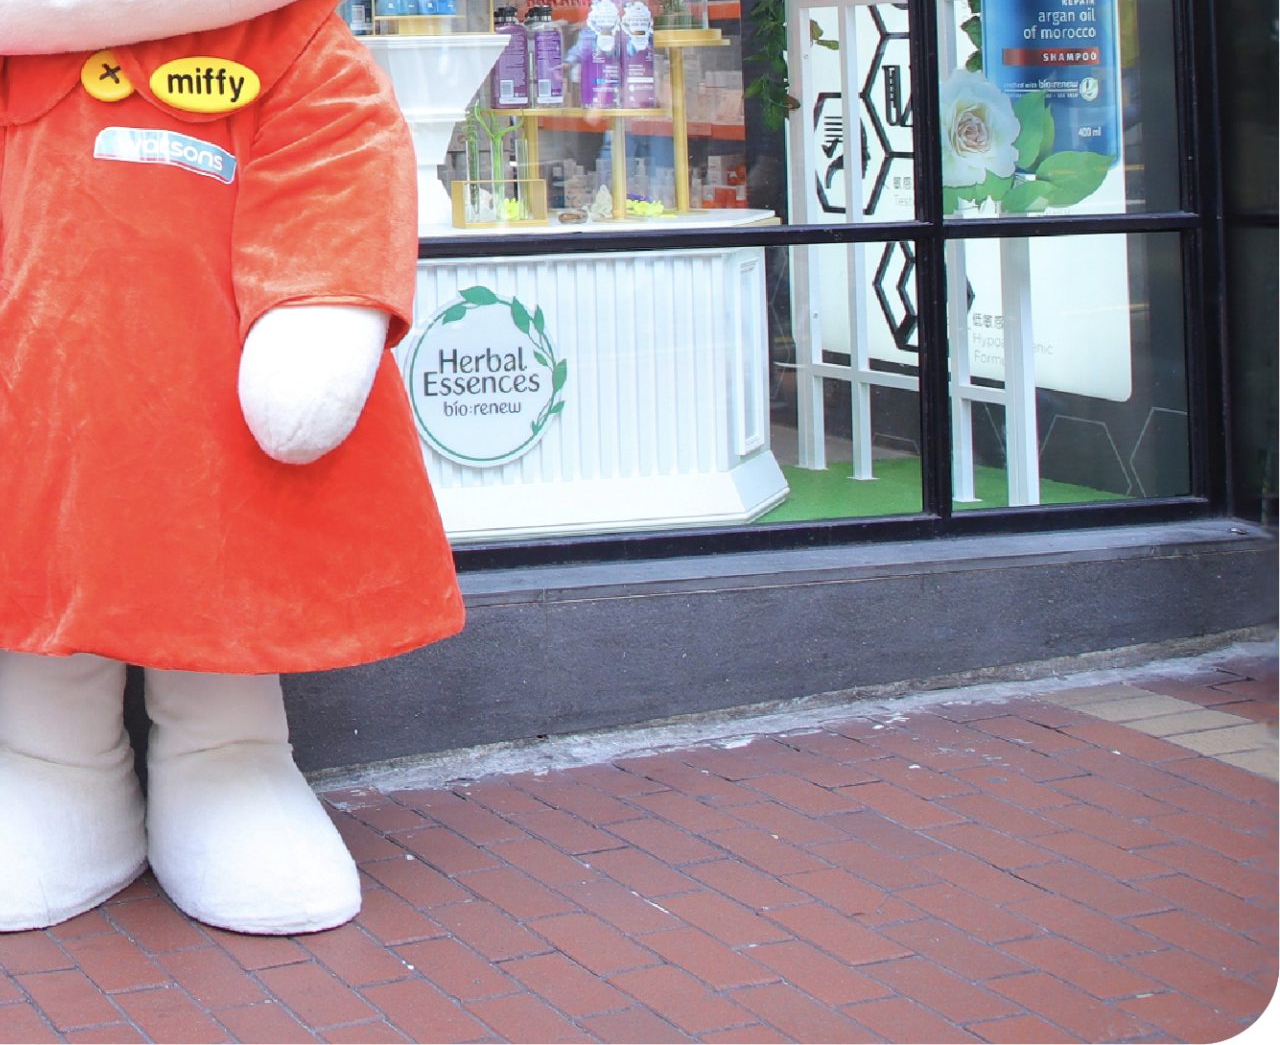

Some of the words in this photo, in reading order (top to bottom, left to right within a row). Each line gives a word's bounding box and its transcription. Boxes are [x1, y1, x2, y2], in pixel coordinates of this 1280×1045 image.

[1038, 11, 1076, 25] argan
[1079, 7, 1097, 22] oil
[1023, 25, 1037, 40] of
[1040, 27, 1097, 40] morocco
[1042, 52, 1097, 61] SHAMPOO
[167, 67, 245, 103] miffy
[438, 346, 527, 374] Herbal
[423, 371, 541, 397] Essences
